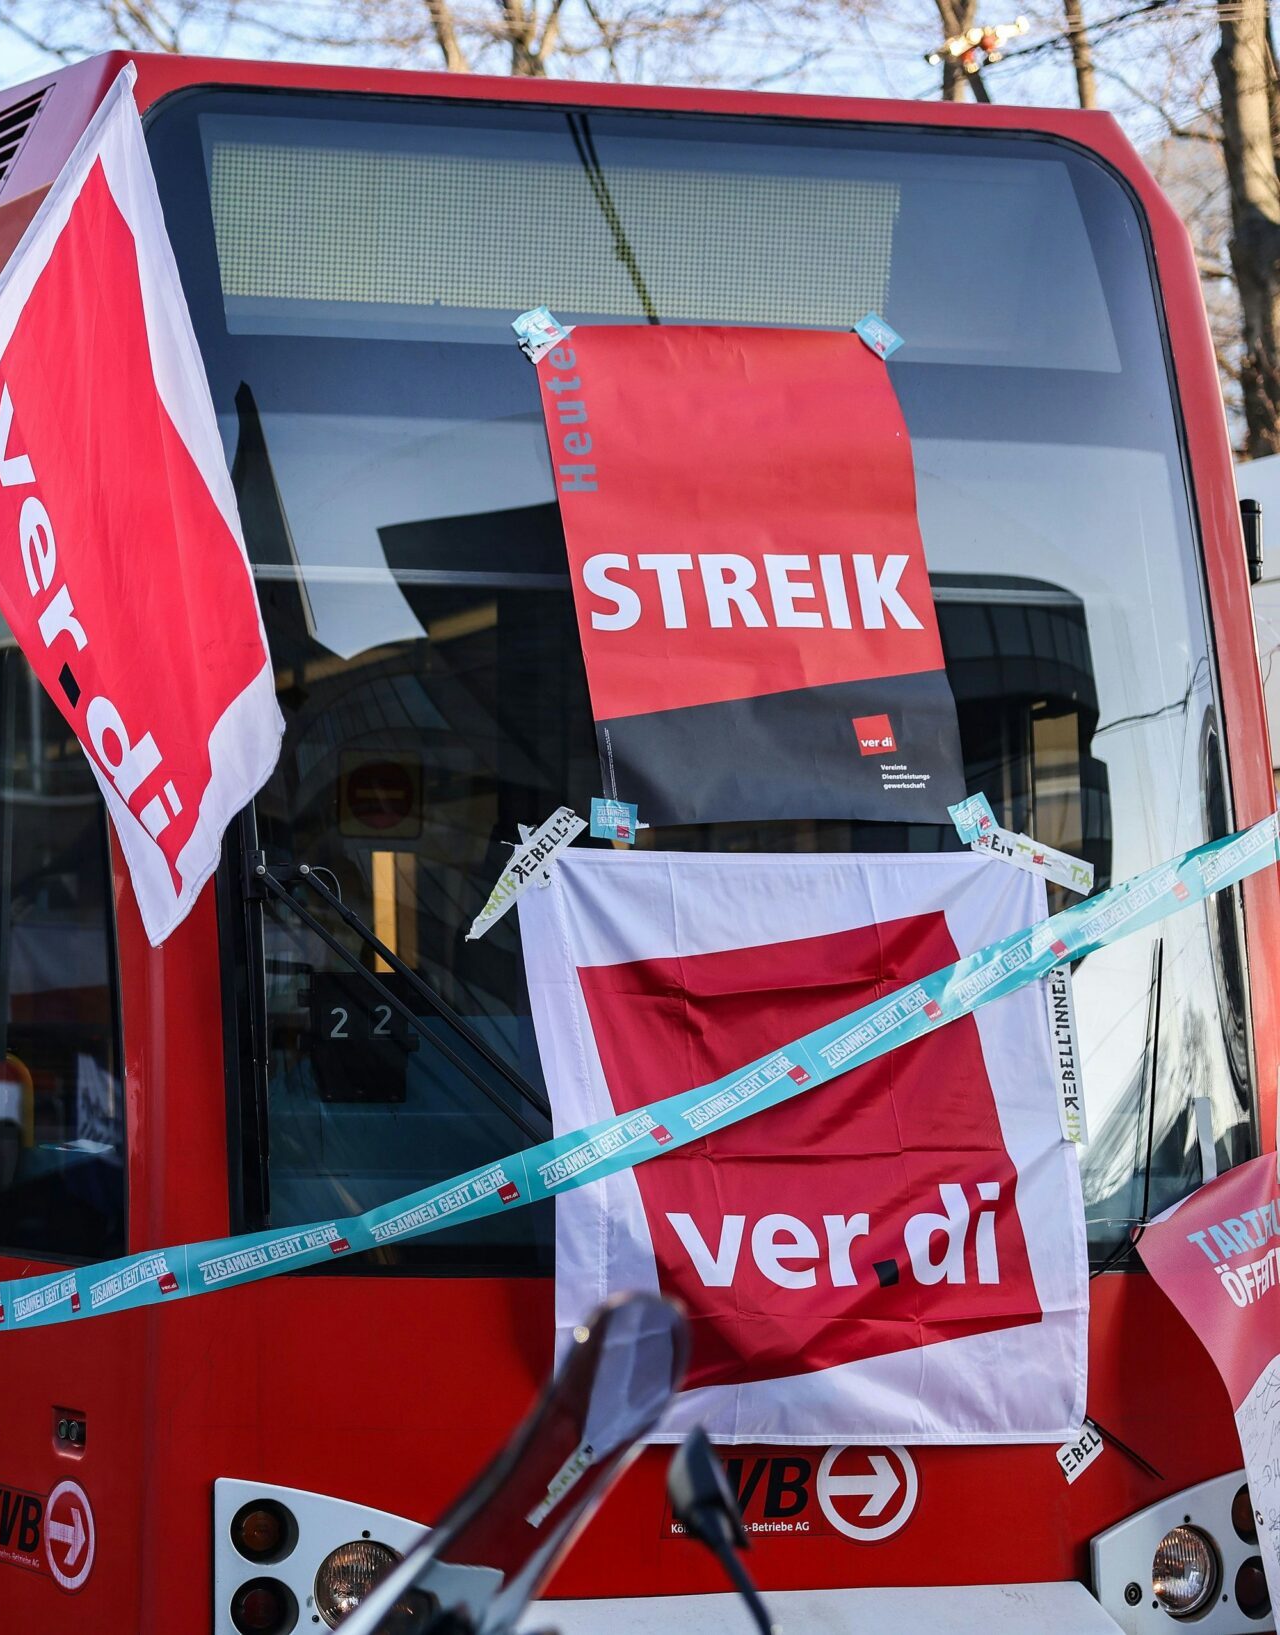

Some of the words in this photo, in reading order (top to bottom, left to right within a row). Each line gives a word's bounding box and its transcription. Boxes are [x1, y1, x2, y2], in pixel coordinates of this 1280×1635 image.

[582, 552, 925, 631] STREIK
[861, 737, 893, 747] ver.di
[882, 773, 931, 781] Dienstleistungs-
[883, 782, 926, 790] gewerkschaft
[954, 962, 1005, 1003] ZUSAMMEN
[1003, 943, 1032, 969] GEHT
[821, 1024, 876, 1066] ZUSAMMEN
[873, 1007, 901, 1032] GEHT
[898, 988, 930, 1014] MEHR
[683, 1091, 738, 1129] ZUSAMMEN
[735, 1074, 765, 1096] GEHT
[762, 1055, 795, 1081] MEHR
[539, 1142, 602, 1186] ZUSAMMEN
[600, 1131, 629, 1153] GEHT
[625, 1114, 658, 1139] MEHR
[372, 1204, 439, 1241] ZUSAMMEN
[439, 1189, 470, 1212] GEHT
[471, 1169, 508, 1197] MEHR
[200, 1249, 268, 1281] ZUSAMMEN
[269, 1236, 303, 1259] GEHT
[304, 1227, 341, 1248] MEHR
[665, 1181, 1000, 1290] ver.di
[13, 1289, 45, 1318] ZUSAMMEN
[44, 1285, 60, 1306] GEHT
[90, 1276, 124, 1305] ZUSAMMEN
[122, 1266, 139, 1288] GEHT
[139, 1257, 169, 1280] MEHR
[742, 1521, 793, 1533] s-Betriebe
[795, 1521, 810, 1531] AG
